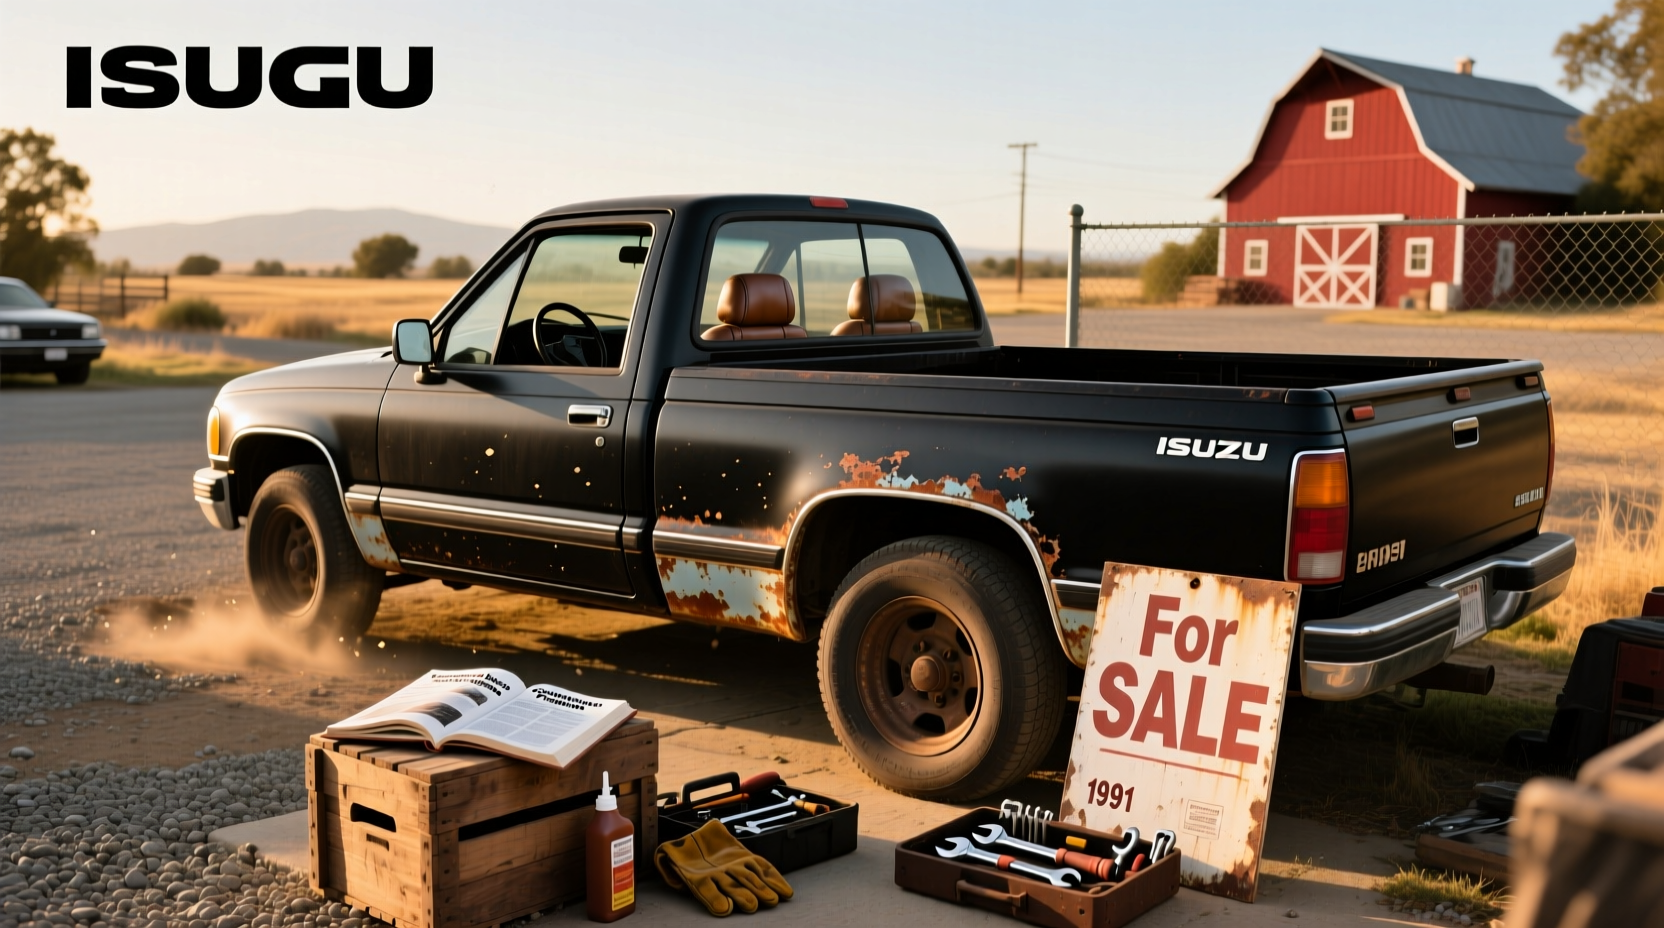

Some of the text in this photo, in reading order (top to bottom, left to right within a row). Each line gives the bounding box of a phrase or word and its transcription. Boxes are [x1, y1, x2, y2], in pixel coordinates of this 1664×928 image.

[1156, 436, 1269, 462] ISUZU
[1139, 593, 1239, 667] For
[1092, 661, 1270, 765] SALE
[1087, 778, 1135, 813] 1991
